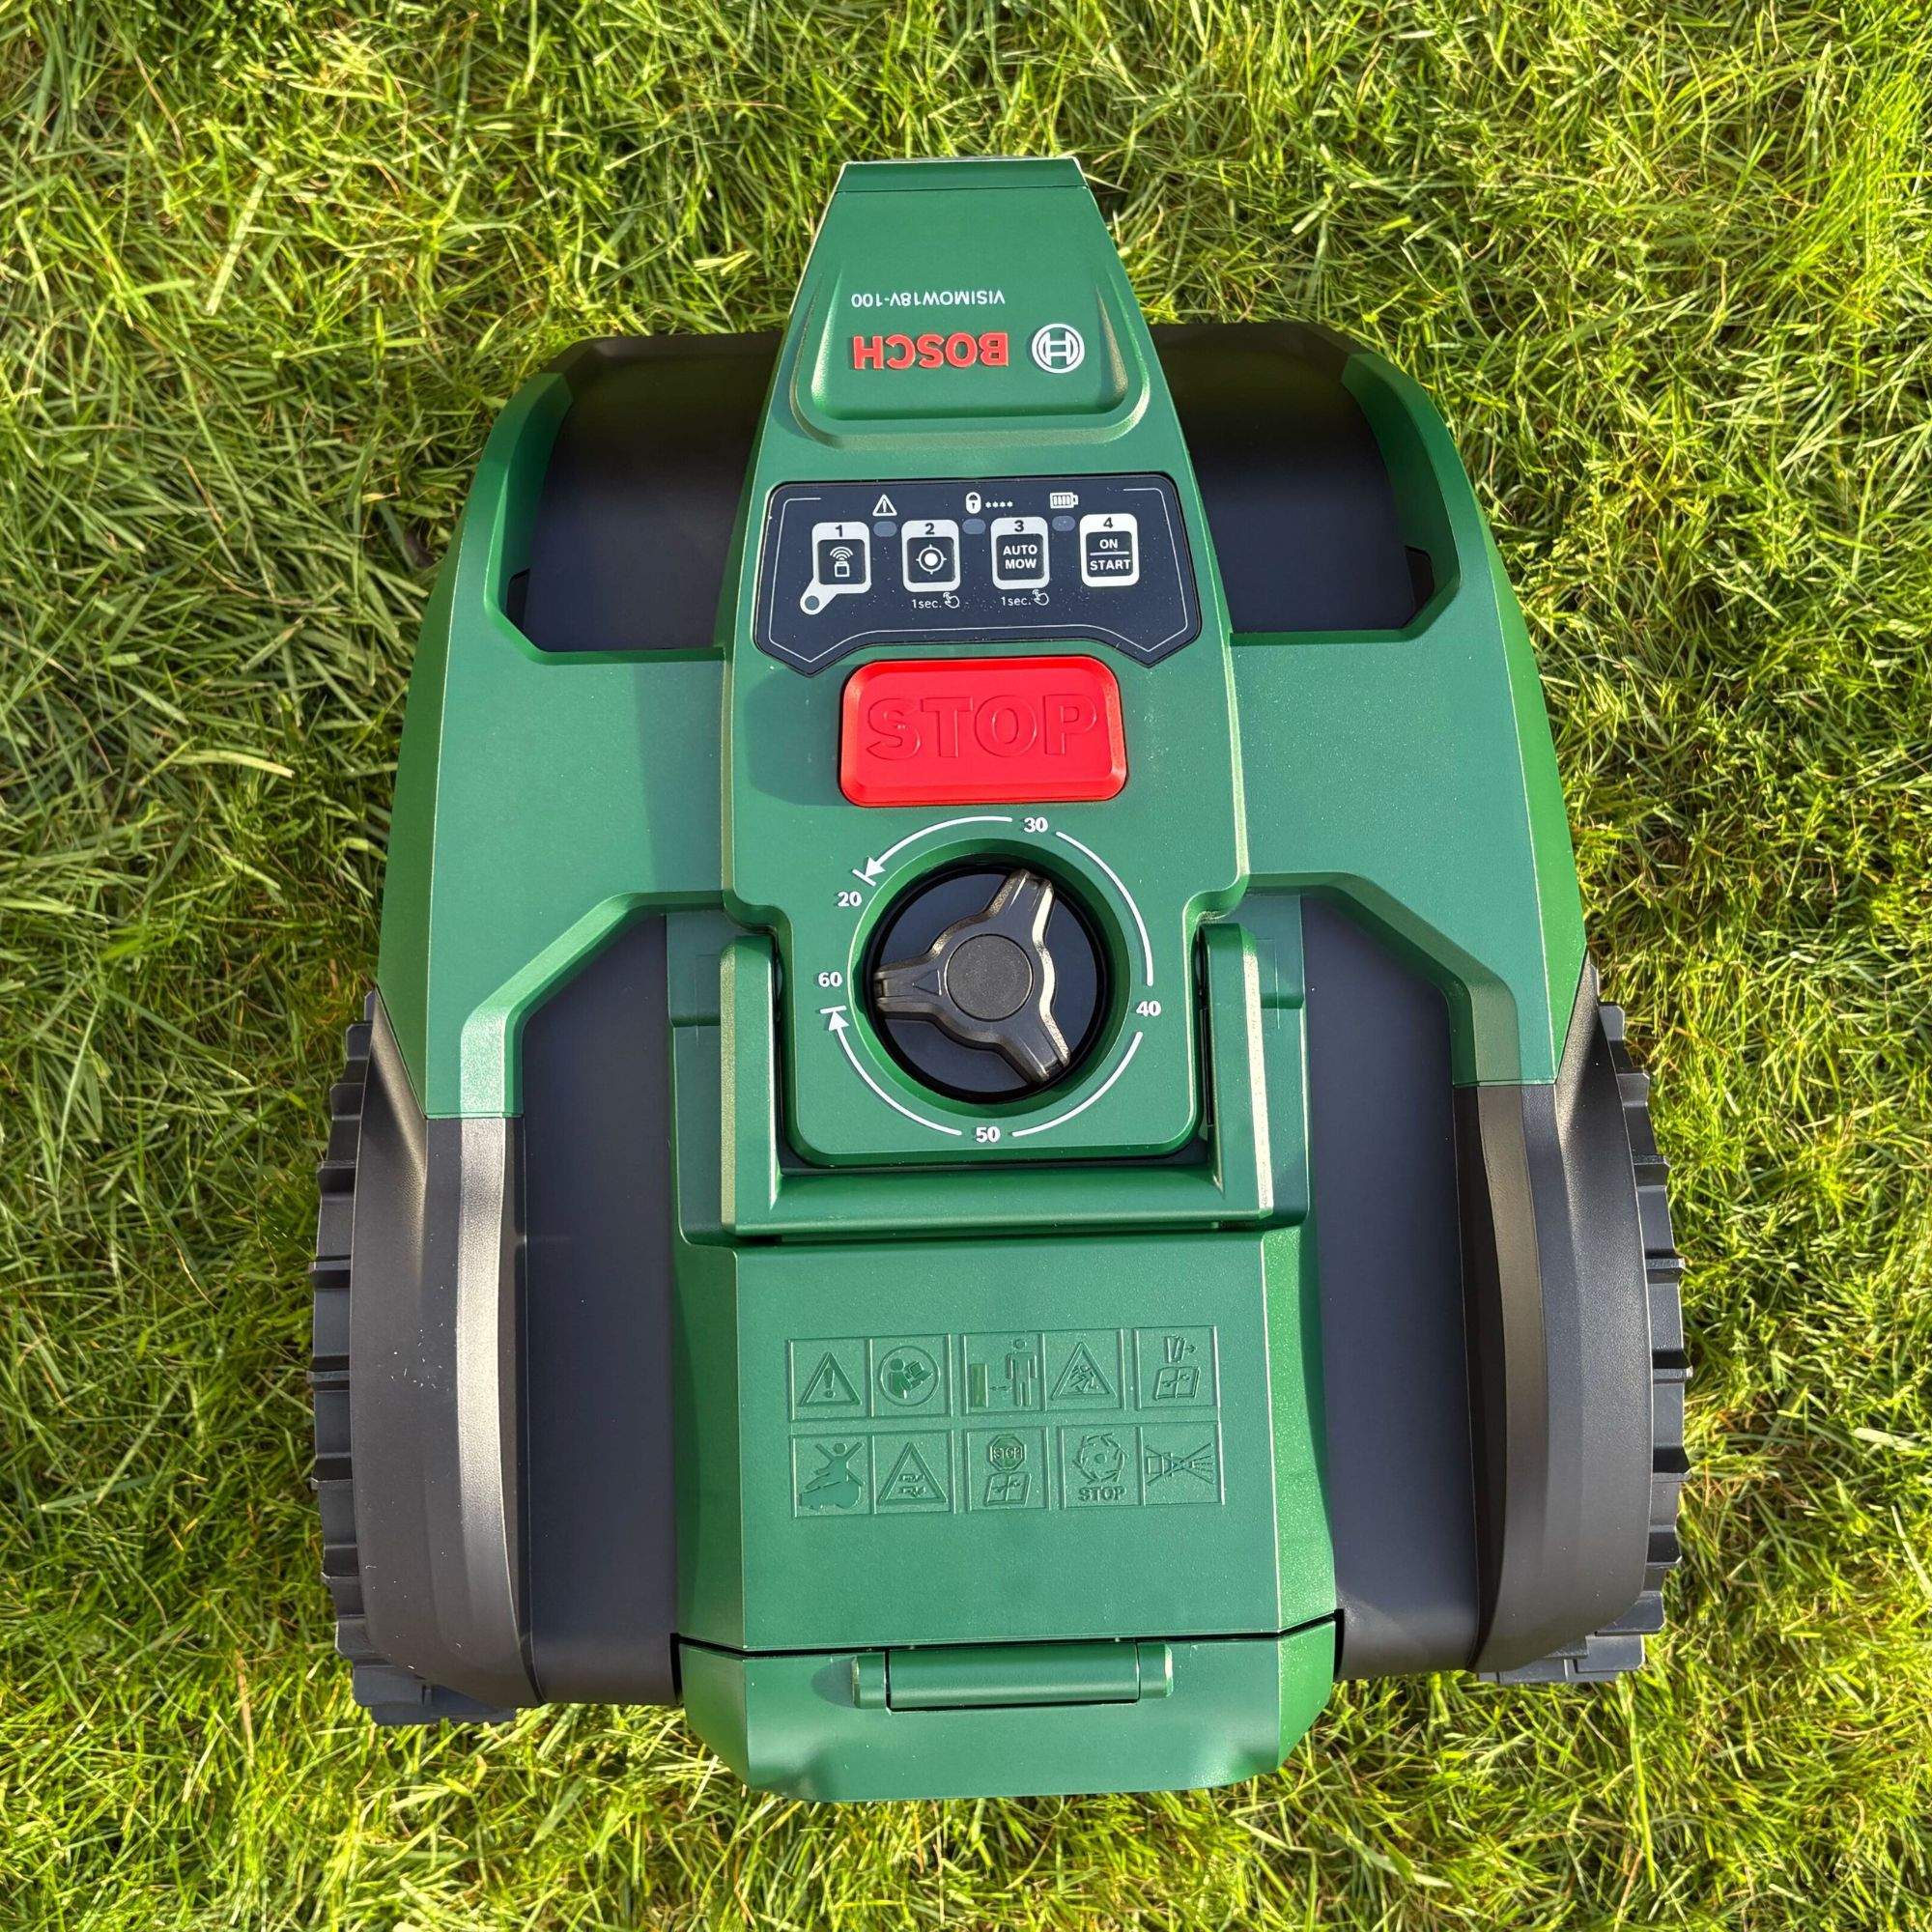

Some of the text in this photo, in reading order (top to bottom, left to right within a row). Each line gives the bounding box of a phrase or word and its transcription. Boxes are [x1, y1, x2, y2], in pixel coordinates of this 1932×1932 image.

[851, 290, 1006, 308] VISIMOW18V-100
[852, 332, 1009, 370] BOSCH
[924, 523, 935, 535] 2
[1014, 520, 1025, 532] 3
[1102, 517, 1114, 529] 4
[835, 525, 843, 537] 1
[1003, 544, 1038, 557] AUTO
[1099, 539, 1119, 551] ON
[1005, 556, 1037, 570] MOW
[1089, 558, 1131, 572] START
[866, 694, 1098, 760] STOP
[1023, 816, 1048, 834] 30
[837, 891, 863, 908] 20
[818, 972, 843, 988] 60
[1136, 1000, 1162, 1017] 40
[975, 1126, 1001, 1144] 50
[993, 1446, 1022, 1461] STOP
[1078, 1485, 1126, 1502] STOP
